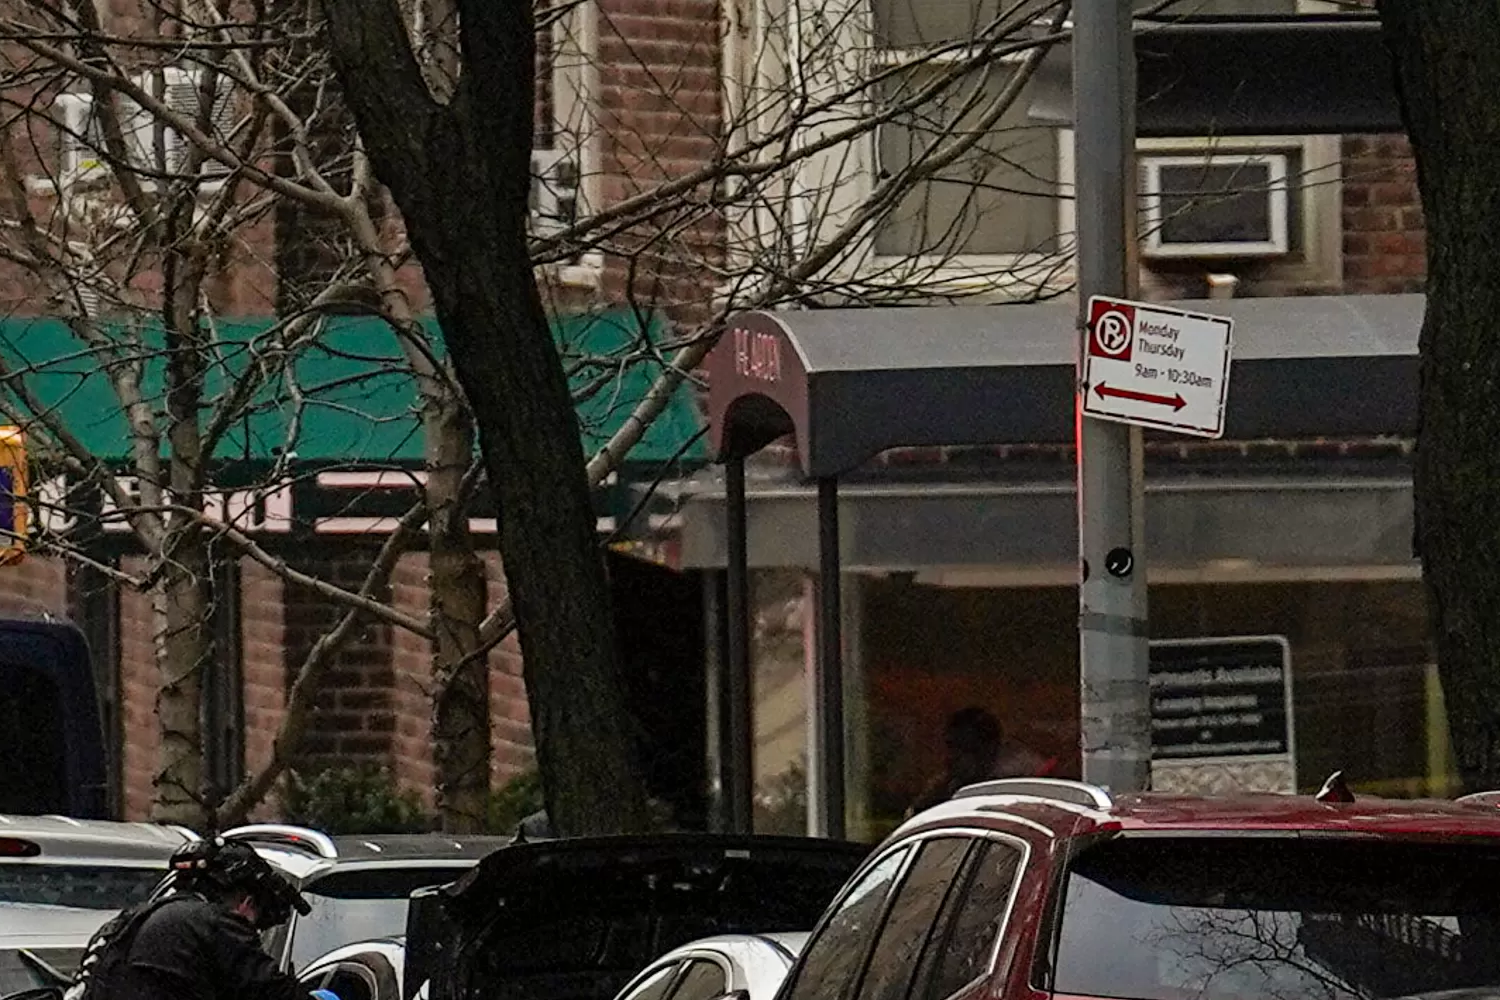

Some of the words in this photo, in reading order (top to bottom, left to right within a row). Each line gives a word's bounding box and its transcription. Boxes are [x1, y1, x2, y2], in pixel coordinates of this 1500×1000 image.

[1138, 320, 1181, 342] Monday
[1138, 338, 1185, 362] Thursday
[1134, 363, 1158, 379] 9am
[1167, 368, 1213, 388] 10:30am
